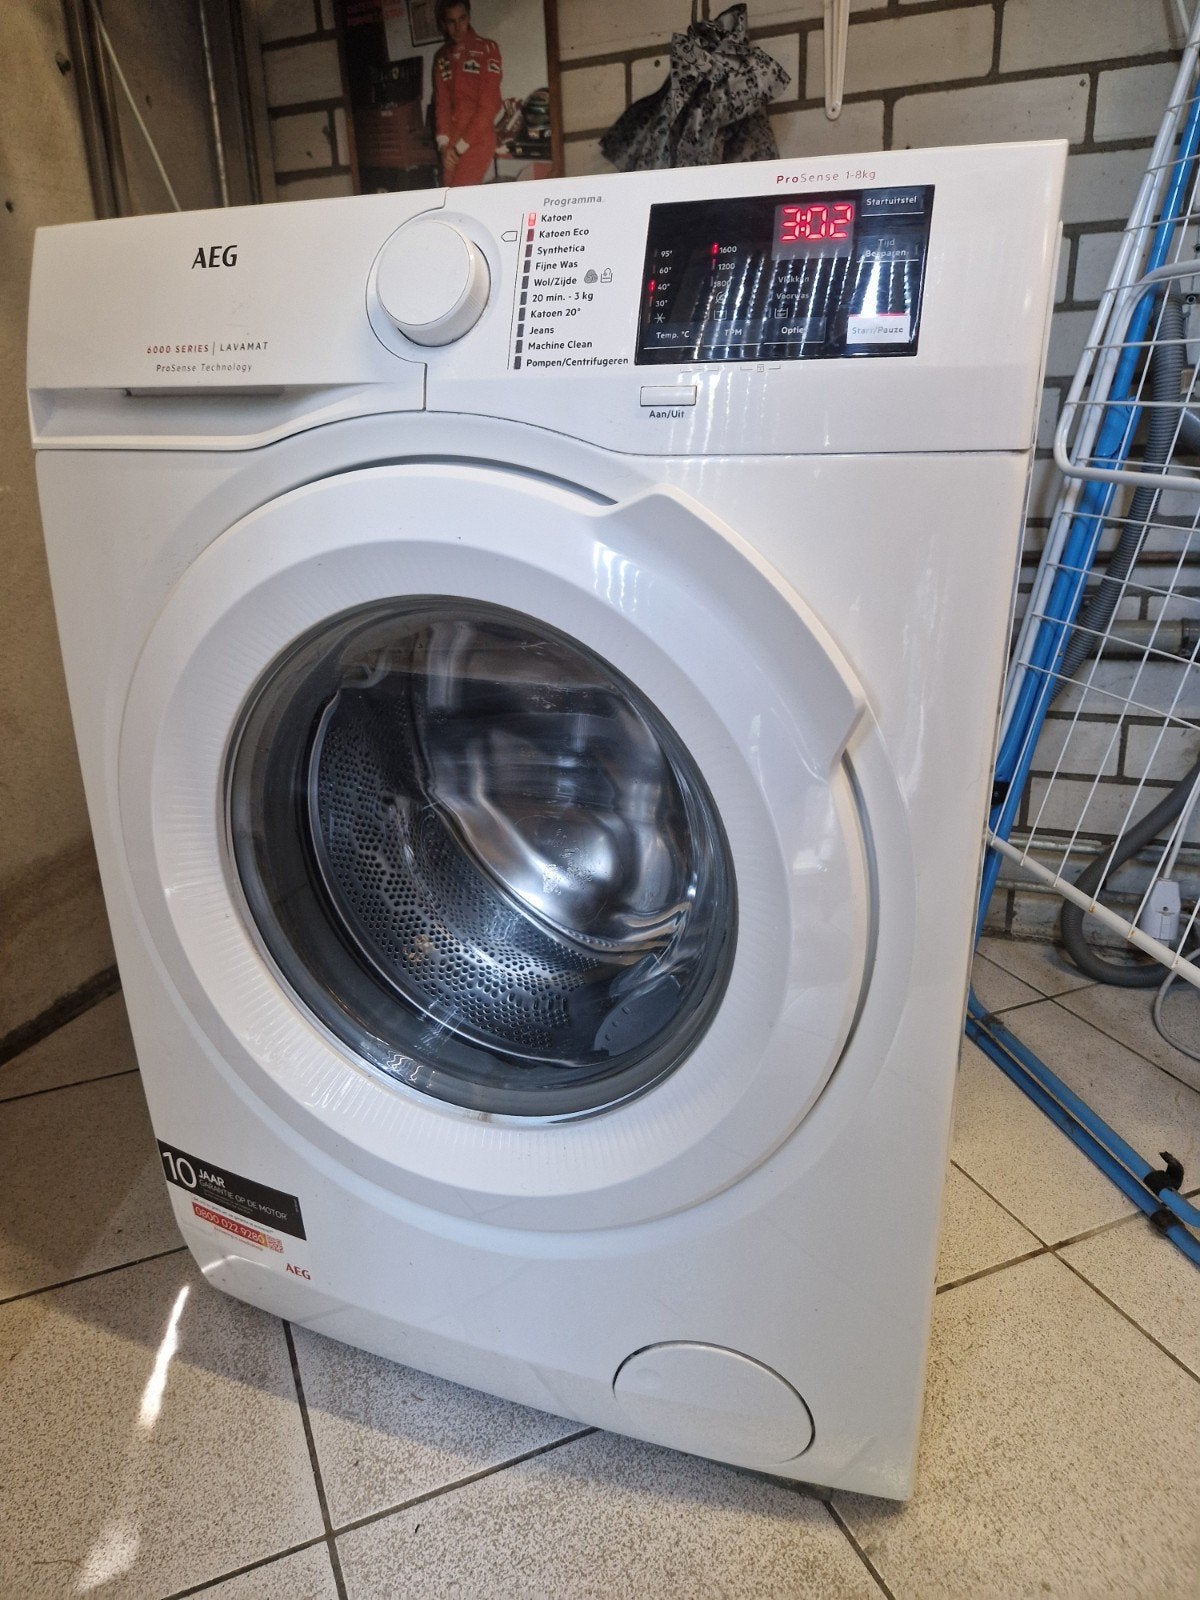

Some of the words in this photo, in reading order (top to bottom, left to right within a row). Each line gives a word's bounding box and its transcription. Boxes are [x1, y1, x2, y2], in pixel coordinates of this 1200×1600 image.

[776, 171, 839, 184] ProSense
[845, 169, 876, 181] 1-8kg
[543, 195, 602, 207] Programma
[866, 195, 917, 206] Startuitstel
[541, 214, 573, 222] Katoen
[782, 205, 852, 241] 3:02
[539, 230, 571, 238] Katoen
[573, 228, 590, 236] Eco
[878, 238, 896, 247] Tijd
[537, 245, 586, 256] Synthetica
[719, 245, 737, 254] 1600
[191, 244, 238, 270] AEG
[535, 262, 557, 271] Fijne
[560, 261, 578, 269] Was
[659, 266, 672, 274] 60°
[718, 263, 736, 271] 1200
[534, 276, 578, 287] Wol/Zijde
[657, 283, 671, 291] 40°
[532, 294, 544, 303] 20
[545, 292, 566, 301] min.
[574, 292, 580, 300] 3
[582, 292, 594, 302] kg
[655, 299, 668, 307] 30°
[530, 310, 563, 318] Katoen
[565, 307, 581, 317] 20°
[529, 326, 555, 335] Jeans
[656, 331, 679, 340] Temp.
[681, 330, 690, 338] °C
[852, 326, 904, 335] Start/Pauze
[147, 346, 171, 354] 6000
[175, 345, 209, 353] SERIES
[220, 341, 269, 352] LAVAMAT
[528, 342, 565, 350] Machine
[567, 341, 593, 349] Clean
[156, 363, 197, 373] ProSense
[201, 362, 253, 373] Technology
[526, 357, 629, 368] Pompen/Centrifugeren
[649, 409, 685, 418] Aan/Uit
[162, 1151, 197, 1188] 10
[199, 1169, 225, 1188] JAAR
[199, 1179, 234, 1199] GARANTIE
[234, 1194, 246, 1205] OP
[247, 1199, 259, 1210] DE
[258, 1204, 288, 1221] MOTOR
[286, 1263, 311, 1280] AEG
